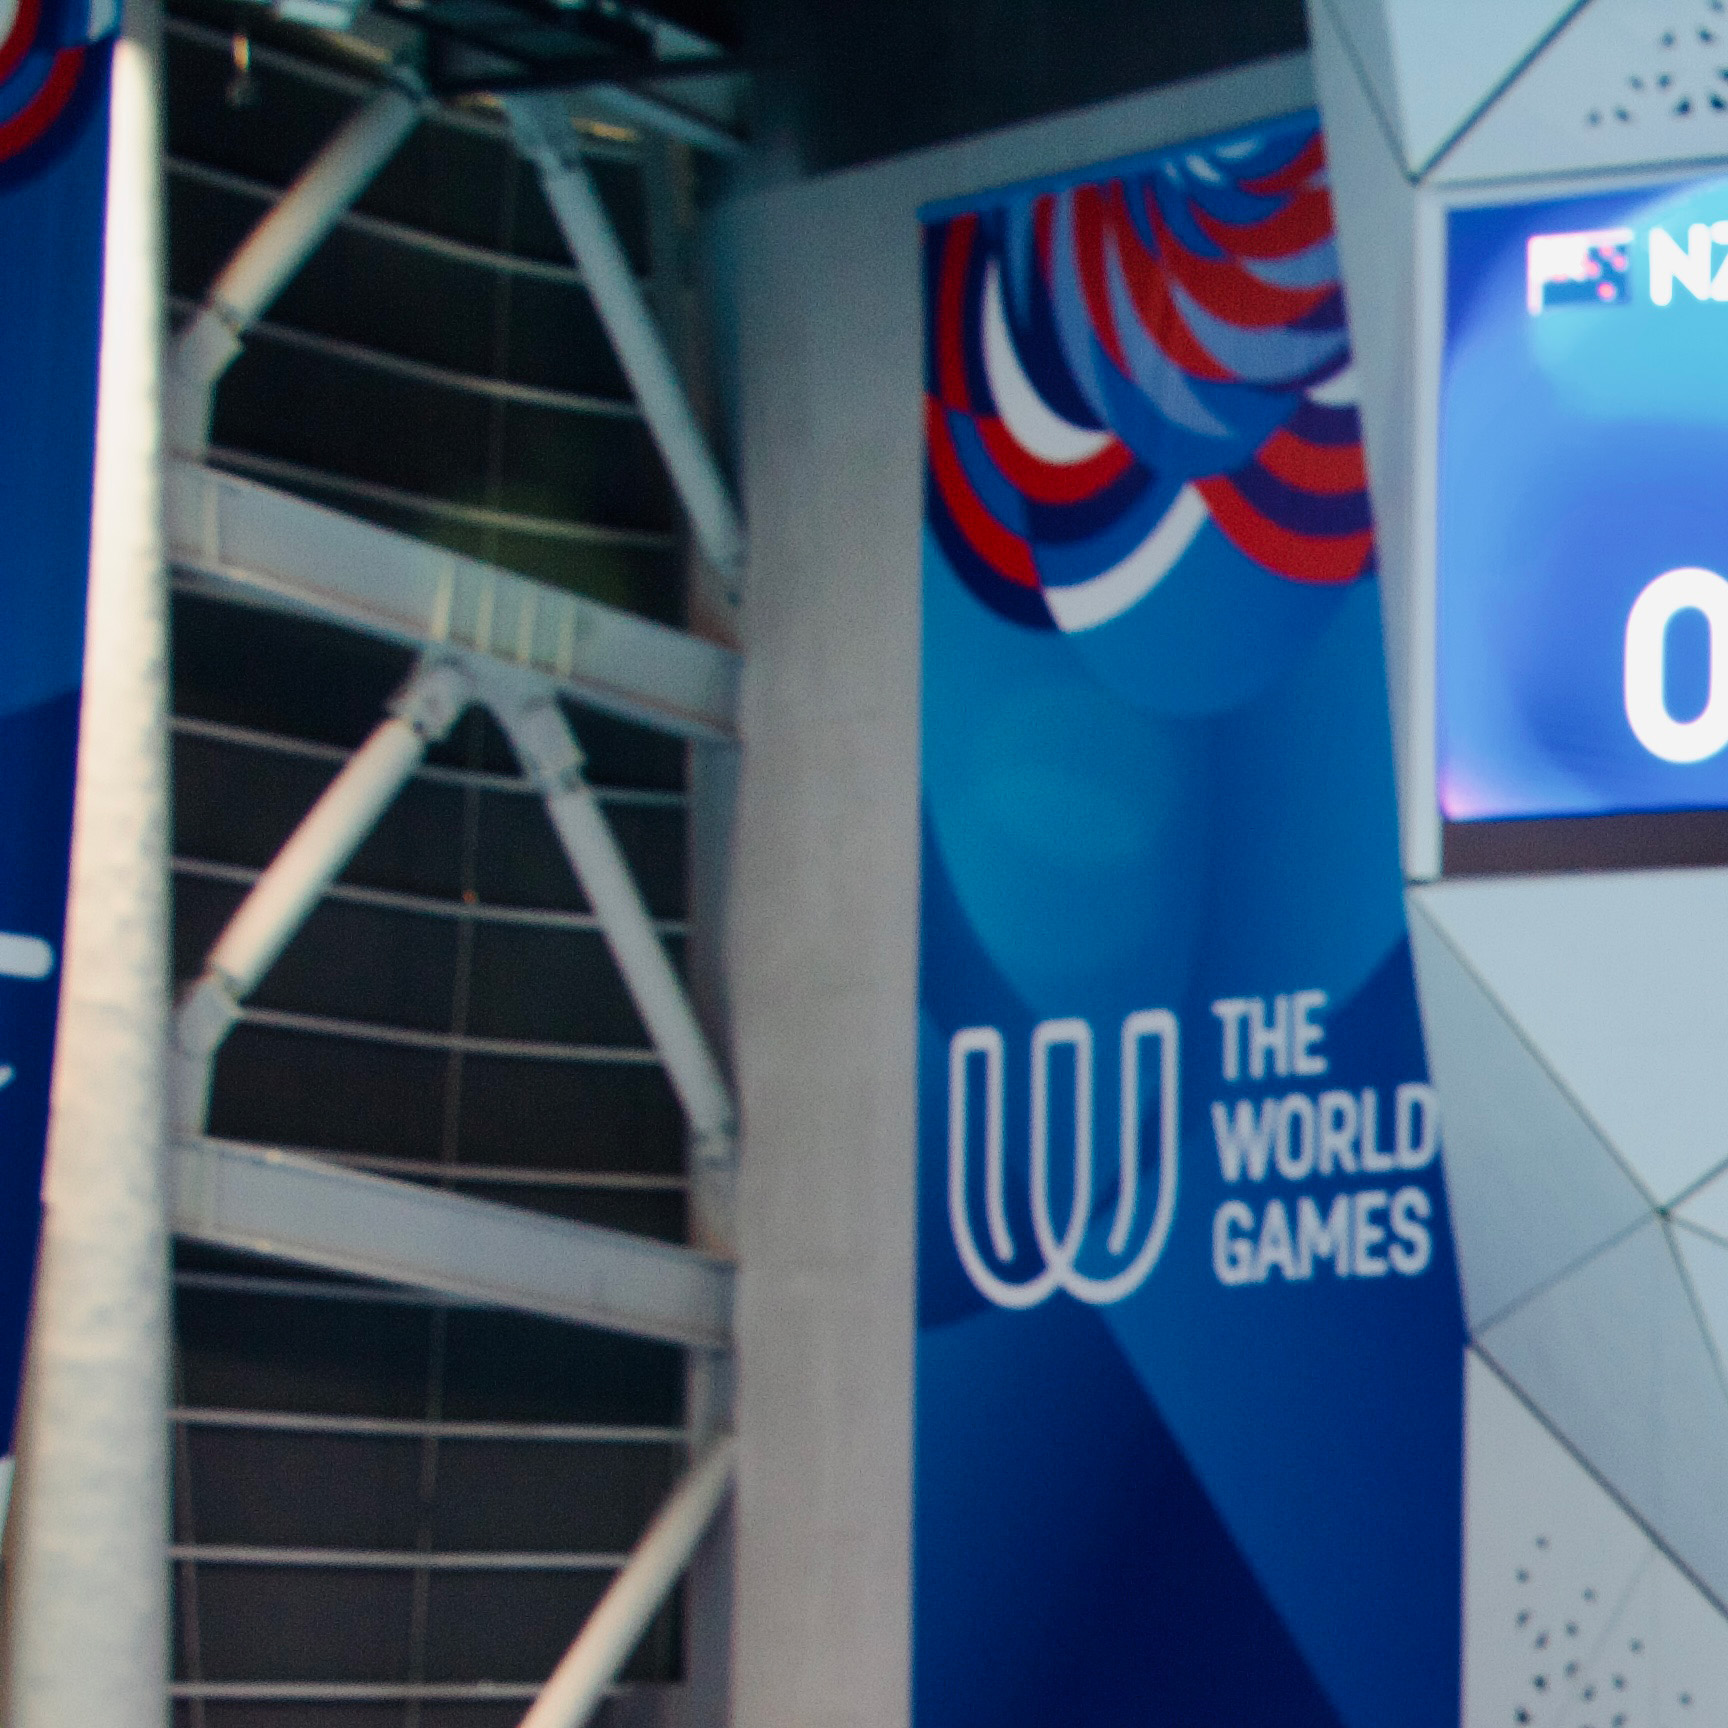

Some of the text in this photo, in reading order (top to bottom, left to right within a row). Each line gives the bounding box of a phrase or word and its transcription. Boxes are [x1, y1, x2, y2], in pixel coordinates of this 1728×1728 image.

[1212, 990, 1329, 1081] THE
[1212, 1083, 1438, 1183] WORLD
[1213, 1187, 1433, 1286] GAMES
